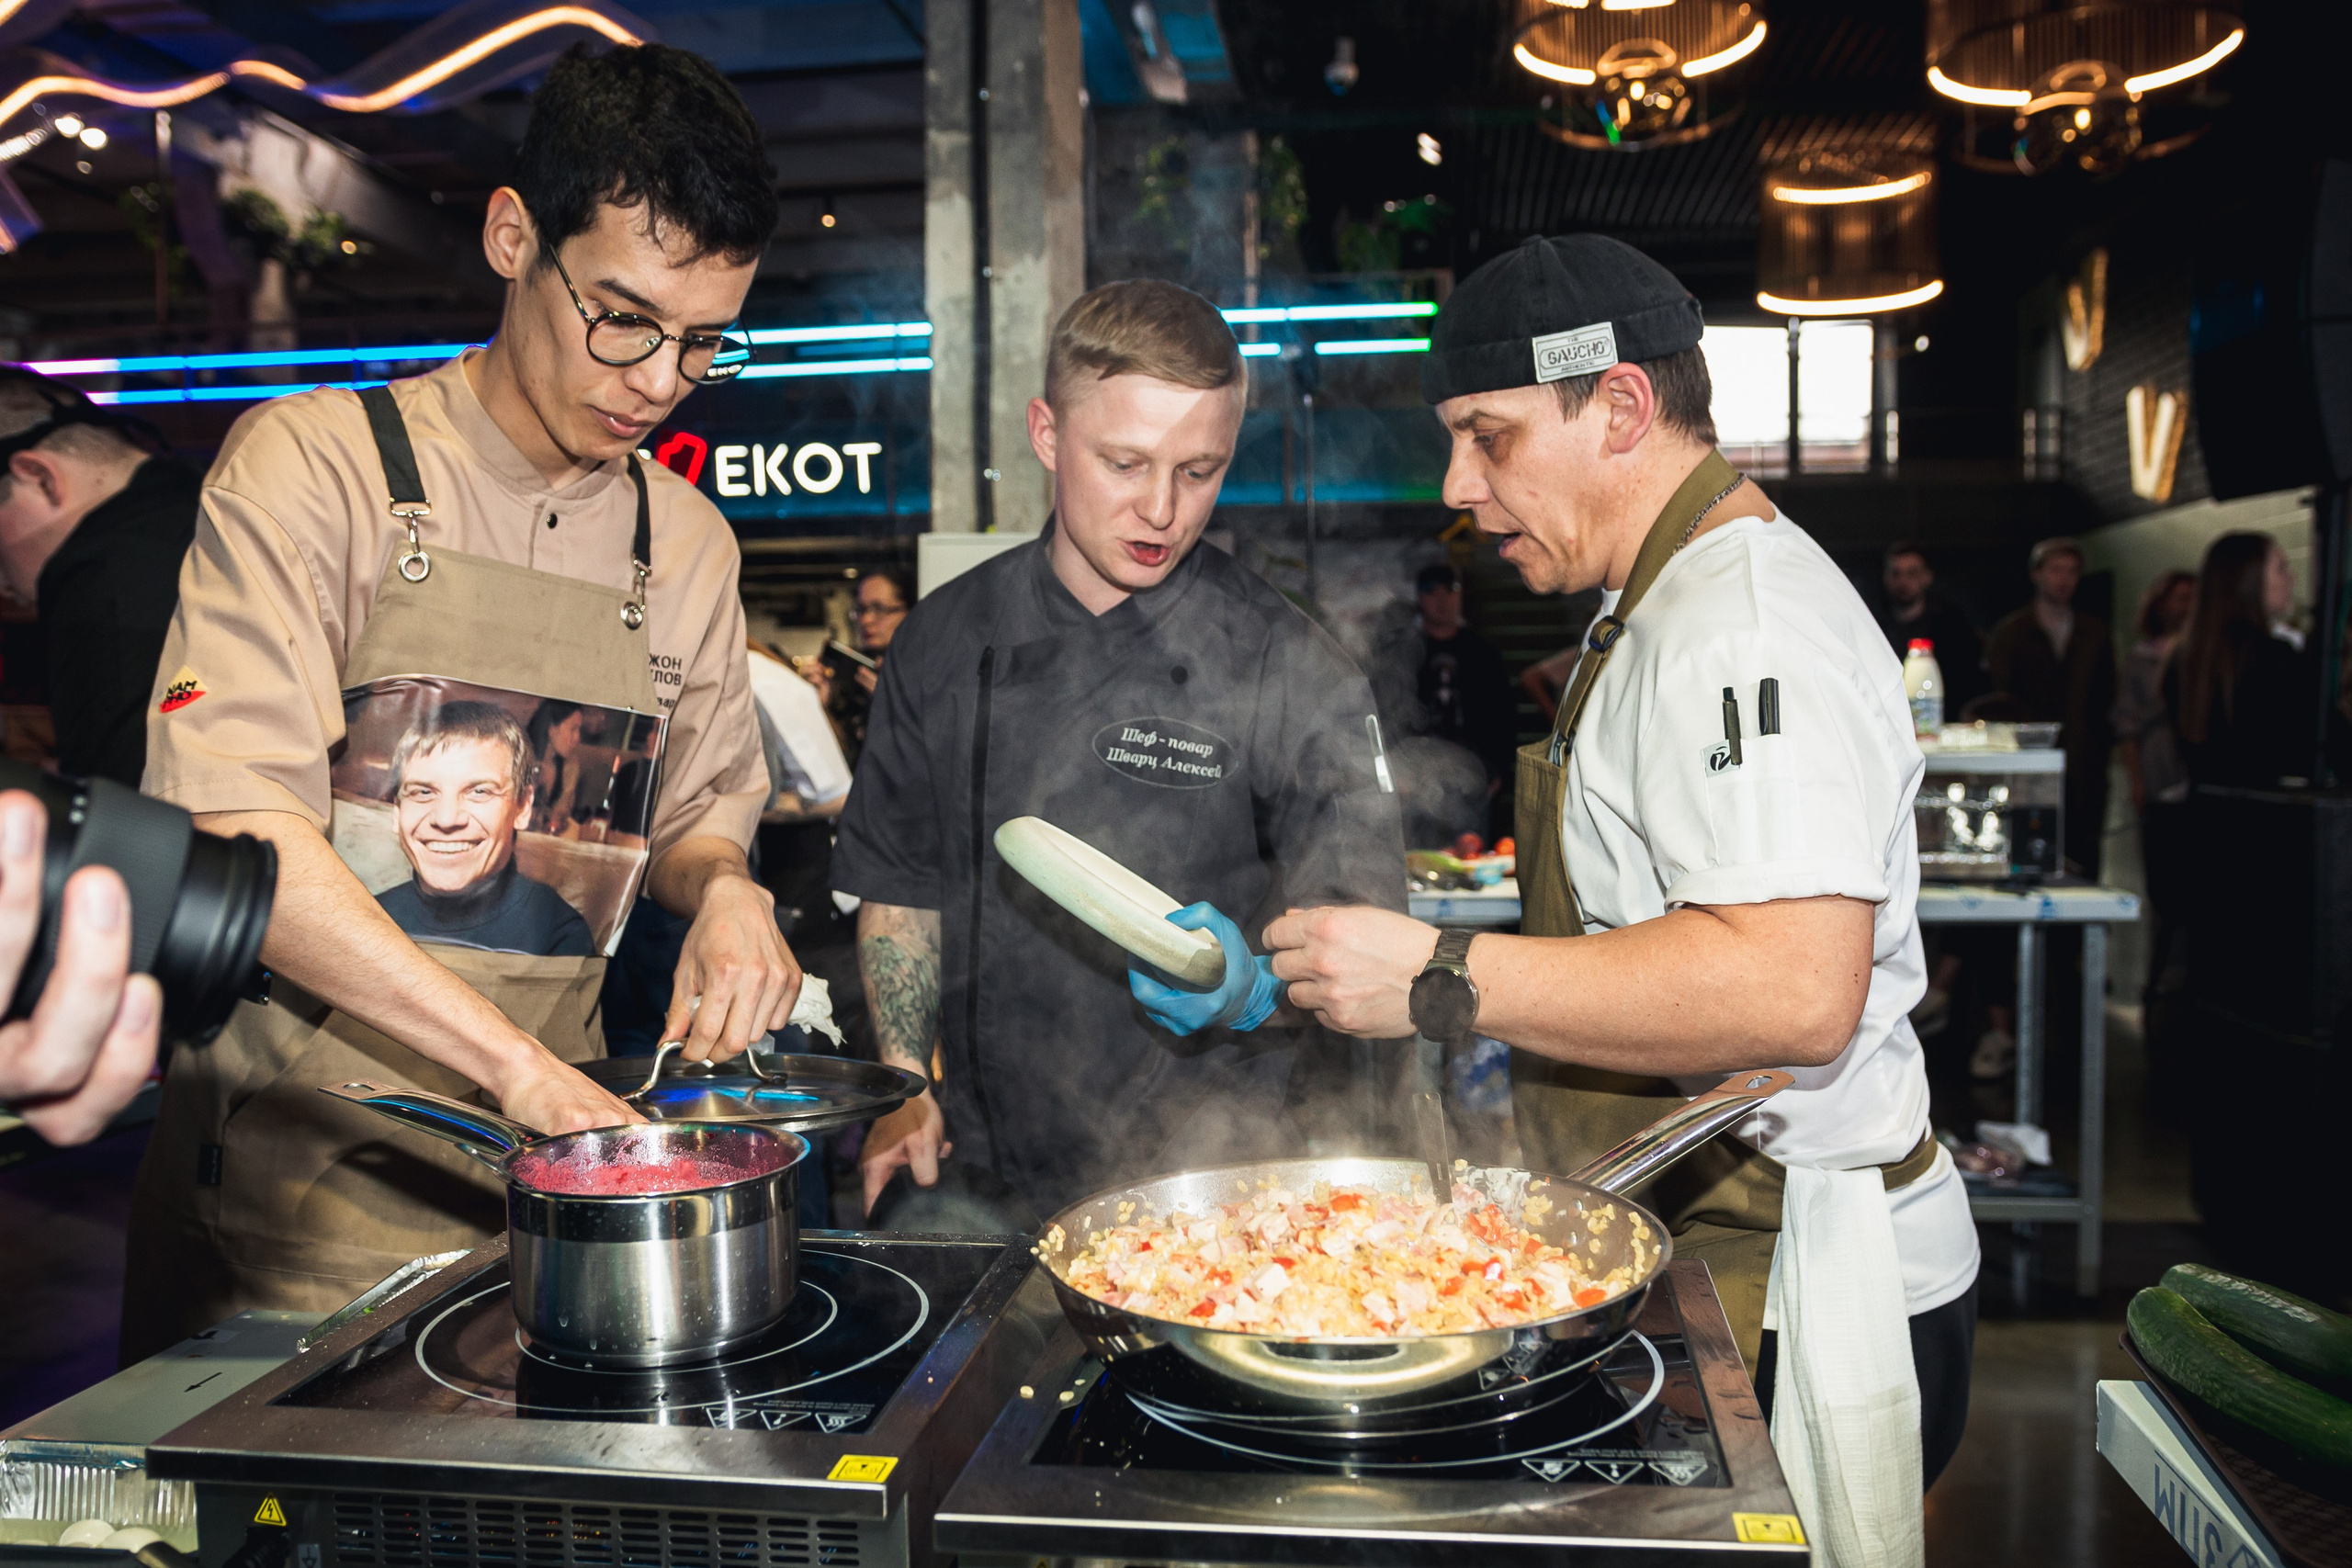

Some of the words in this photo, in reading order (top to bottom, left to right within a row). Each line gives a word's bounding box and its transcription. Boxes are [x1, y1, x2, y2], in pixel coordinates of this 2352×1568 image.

[1547, 341, 1605, 365] GAUCHO
[650, 669, 682, 686] ЛОВ
[1105, 746, 1159, 770] Шварц
[1159, 755, 1223, 779] Алексей
